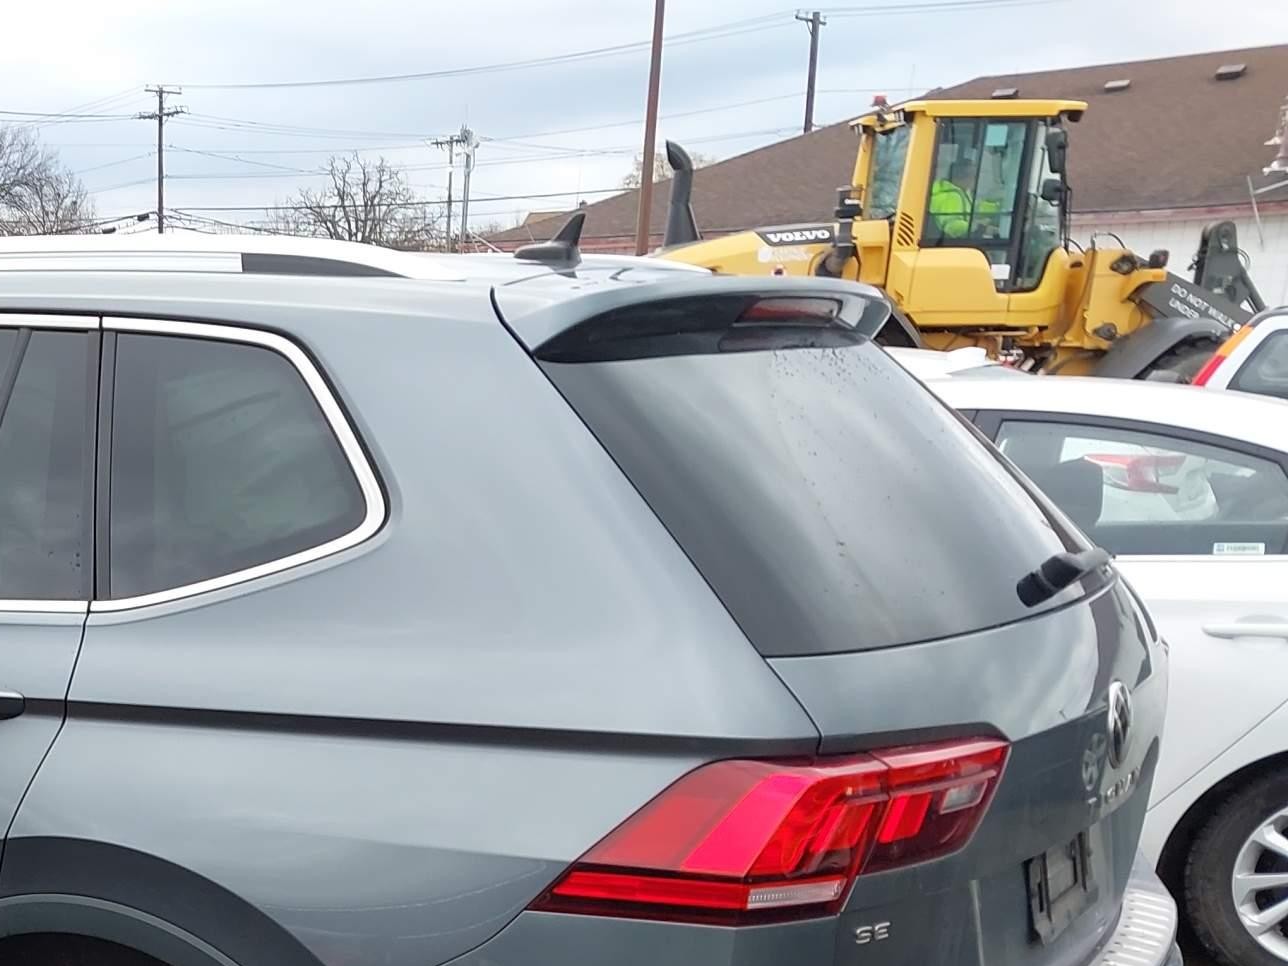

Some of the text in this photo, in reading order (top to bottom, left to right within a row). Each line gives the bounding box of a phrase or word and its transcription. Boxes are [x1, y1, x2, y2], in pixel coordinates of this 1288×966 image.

[766, 229, 831, 243] VOLVO
[1169, 297, 1200, 320] UNDER
[1171, 283, 1188, 298] DO
[1186, 293, 1210, 311] NOT
[855, 921, 891, 945] SE
